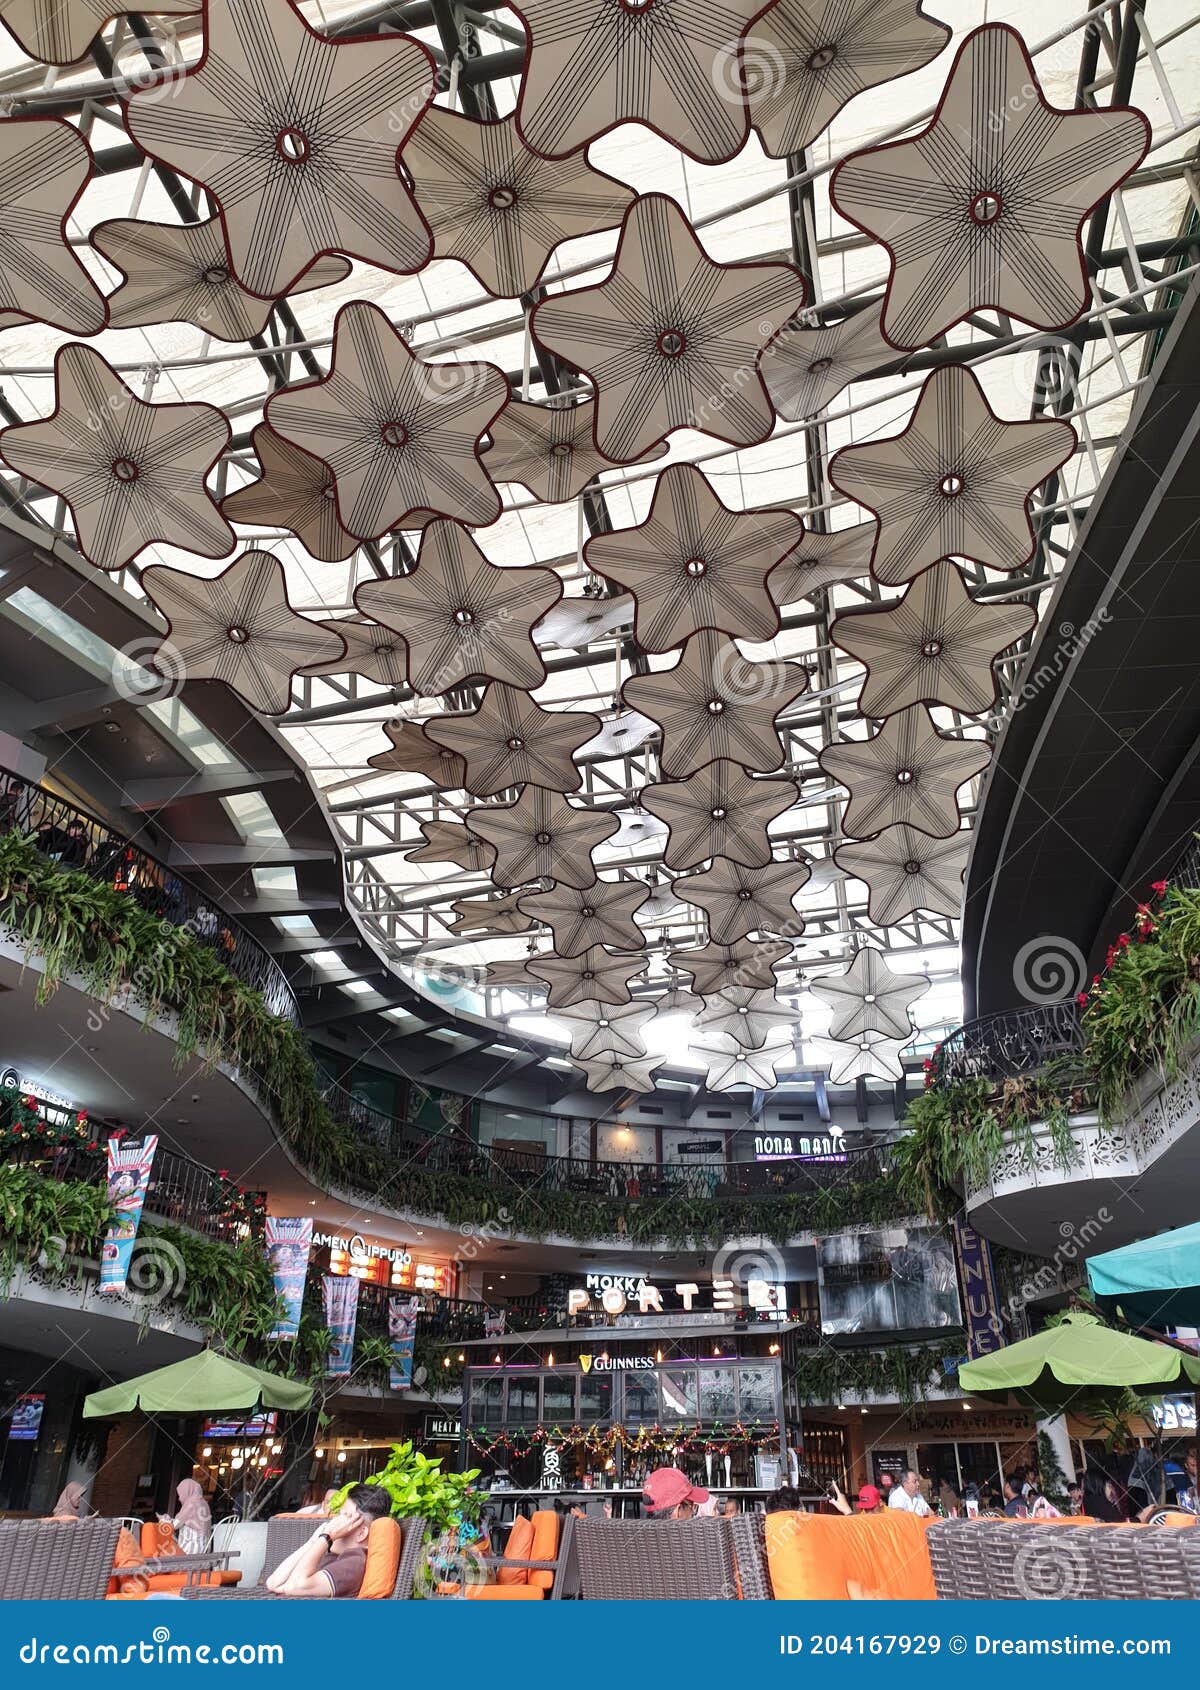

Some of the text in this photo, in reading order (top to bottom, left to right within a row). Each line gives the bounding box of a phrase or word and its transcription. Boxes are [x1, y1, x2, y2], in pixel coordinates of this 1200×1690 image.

[368, 1245, 412, 1265] IPPUDO
[586, 1274, 646, 1291] MOKKA
[568, 1279, 778, 1316] PORTER
[594, 1356, 655, 1370] GUINNESS
[432, 1421, 452, 1433] MEAT
